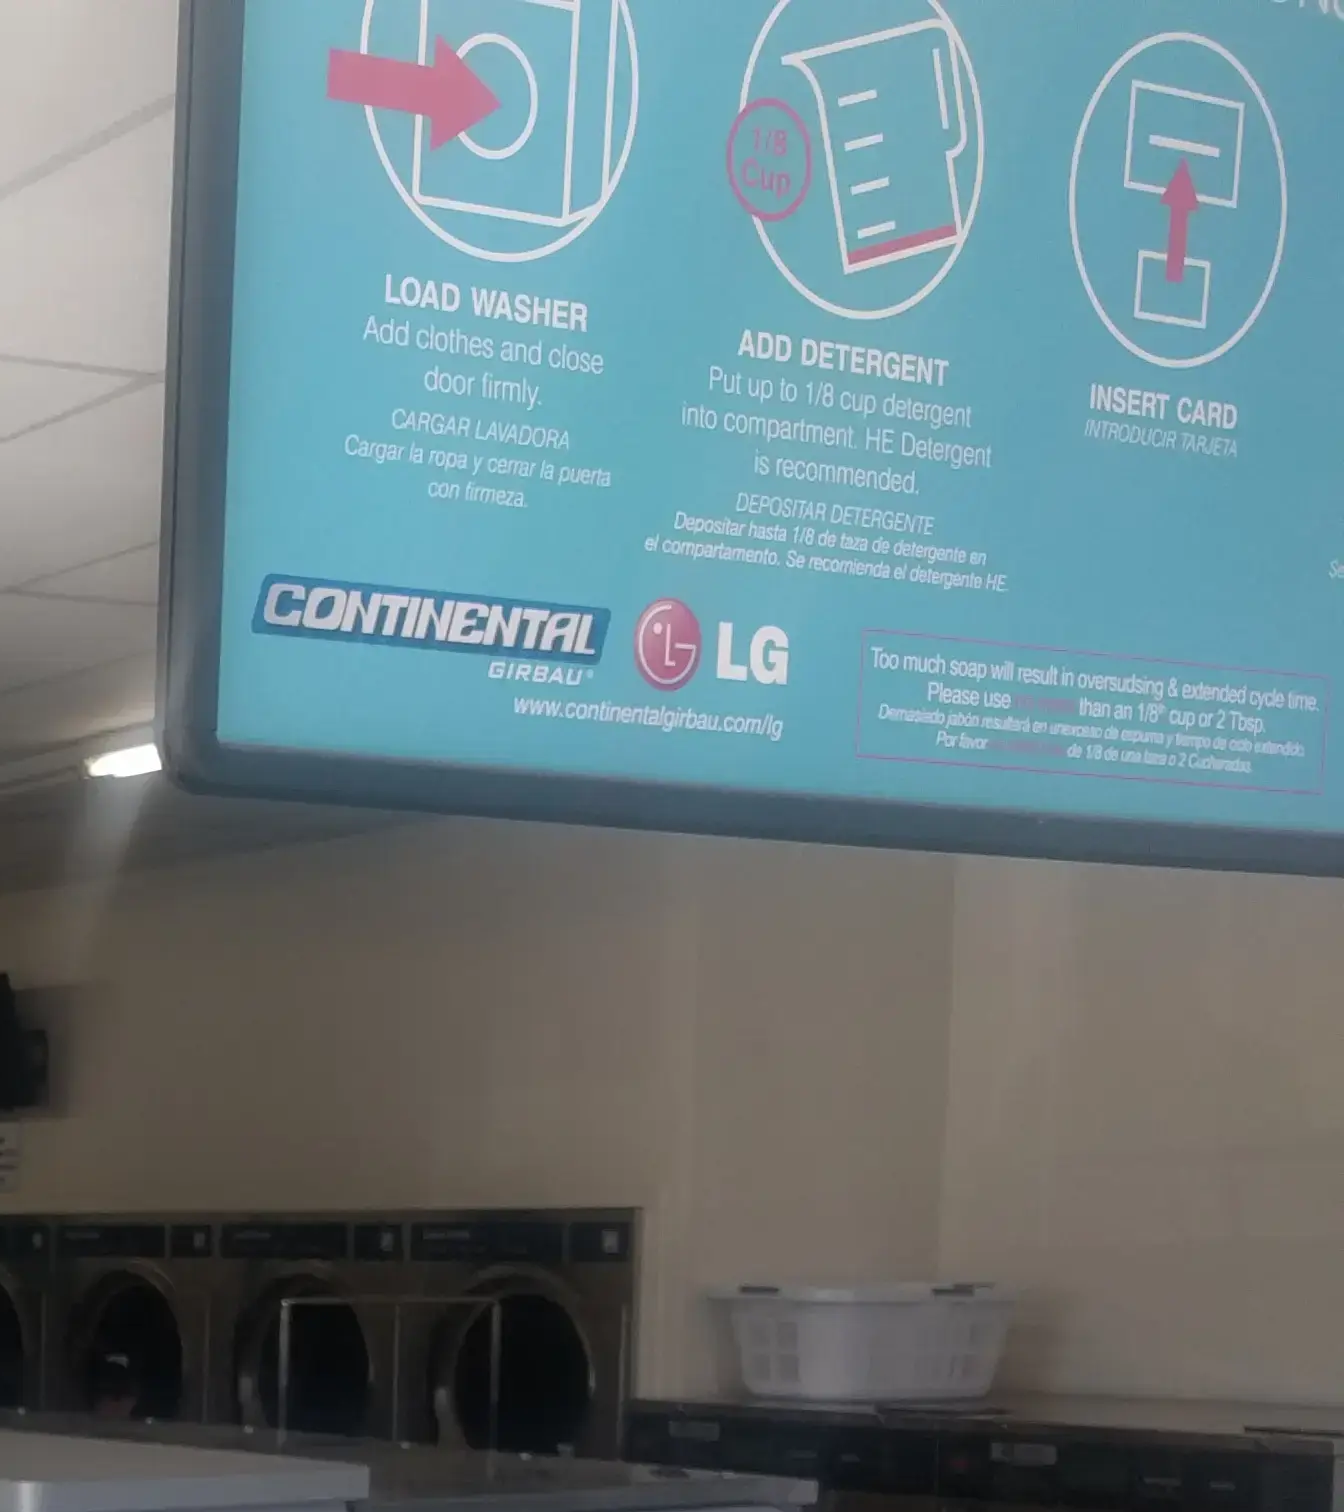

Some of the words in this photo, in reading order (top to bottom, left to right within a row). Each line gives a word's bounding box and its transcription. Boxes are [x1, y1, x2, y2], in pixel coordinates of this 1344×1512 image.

[753, 127, 788, 156] 1/8
[741, 156, 791, 199] Cup
[385, 273, 460, 312] LOAD
[471, 286, 588, 332] WASHER
[363, 315, 410, 347] Add
[416, 324, 494, 358] clothes
[500, 340, 542, 365] and
[548, 345, 604, 375] close
[737, 329, 792, 362] ADD
[801, 338, 949, 387] DETERGENT
[424, 366, 474, 395] door
[482, 372, 542, 411] firmly.
[709, 365, 741, 395] Put
[747, 376, 773, 401] up
[779, 376, 797, 402] to
[805, 381, 834, 408] 1/8
[840, 390, 876, 419] cup
[882, 393, 972, 430] detergent
[1090, 382, 1170, 420] INSERT
[1177, 397, 1238, 429] CARD
[392, 408, 470, 437] CARGAR
[475, 420, 570, 450] LAVADORA
[682, 400, 717, 430] into
[723, 410, 857, 450] compartment.
[865, 428, 894, 454] HE
[901, 432, 992, 470] Detergent
[1084, 419, 1177, 448] INTRODUCIR
[1179, 432, 1238, 458] TARJETA
[345, 434, 405, 463] Cargar
[409, 440, 423, 463] la
[428, 449, 467, 471] ropa
[472, 456, 483, 476] y
[487, 455, 536, 477] cerrar
[540, 459, 554, 480] la
[558, 464, 612, 487] puerta
[754, 449, 770, 475] is
[775, 456, 920, 495] recommended.
[428, 480, 459, 498] con
[465, 482, 528, 508] firmeza.
[736, 492, 827, 522] DEPOSITAR
[831, 502, 935, 536] DETERGENTE
[645, 533, 661, 552] el
[786, 550, 805, 569] Se
[809, 553, 890, 580] recomienda
[893, 562, 906, 581] el
[910, 565, 982, 590] detergente
[674, 511, 744, 537] Depositar
[748, 517, 787, 542] hasta
[792, 526, 815, 546] 1/8
[817, 527, 837, 549] de
[872, 535, 890, 555] de
[893, 539, 967, 564] detergente
[264, 583, 597, 656] CONTINENTAL
[716, 621, 789, 686] LG
[871, 646, 899, 670] Too
[903, 653, 946, 675] much
[949, 659, 987, 683] soap
[990, 660, 1014, 681] will
[1017, 665, 1058, 686] result
[1061, 669, 1074, 687] in
[1077, 673, 1164, 700] oversudsing
[1167, 677, 1178, 698] &
[1181, 682, 1247, 706] extended
[1249, 688, 1285, 711] cycle
[514, 696, 784, 742] www.continentalgirbau.com/lg
[927, 682, 980, 708] Please
[984, 690, 1011, 709] use
[1079, 697, 1111, 718] than
[1113, 703, 1133, 722] an
[1169, 710, 1195, 731] cup
[1198, 711, 1213, 729] or
[1215, 709, 1226, 730] 2
